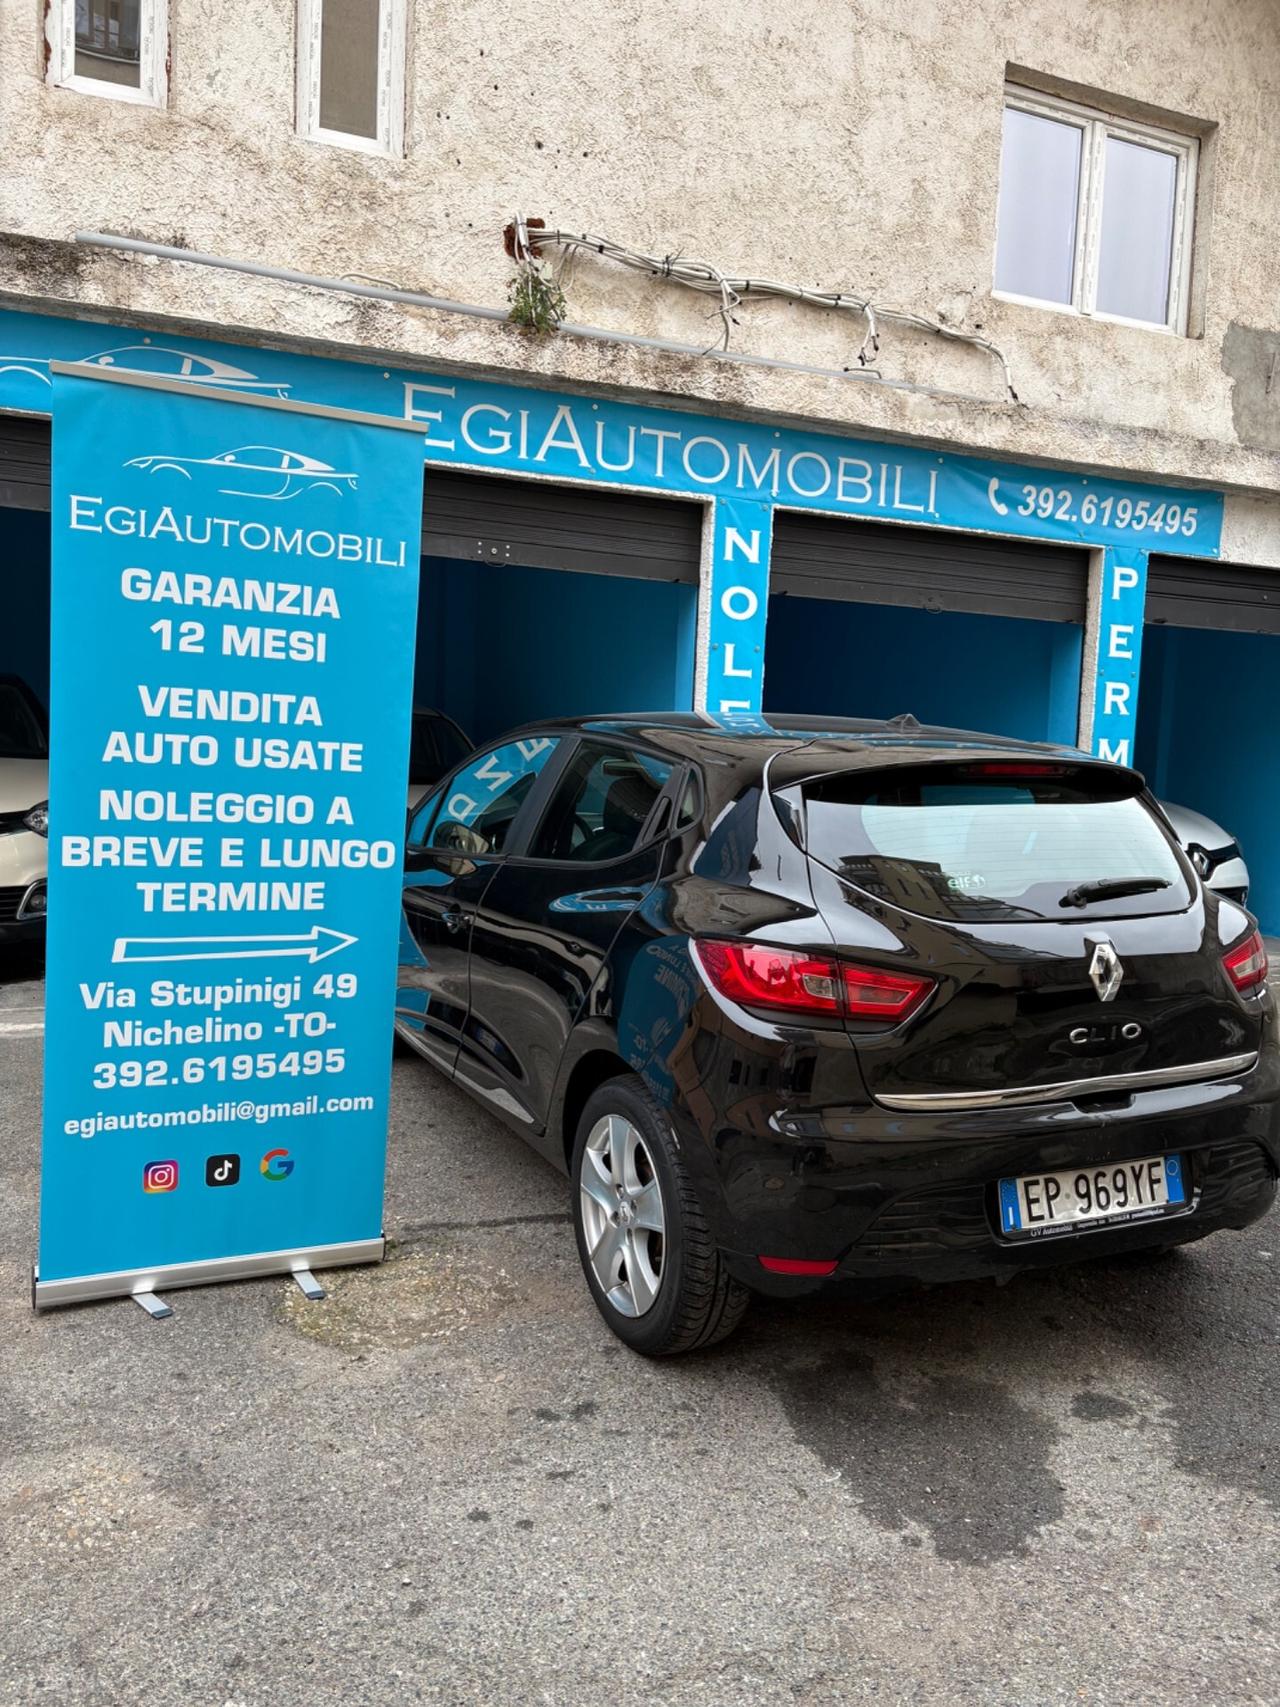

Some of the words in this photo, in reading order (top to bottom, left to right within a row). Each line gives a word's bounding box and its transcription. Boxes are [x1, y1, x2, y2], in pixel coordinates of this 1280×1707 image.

[1017, 484, 1199, 537] 392.6195495
[121, 567, 341, 619] GARANZIA
[150, 618, 205, 654] 12
[222, 624, 327, 663] MESI
[138, 684, 323, 727] VENDITA
[102, 731, 219, 766] AUTO
[234, 737, 364, 773] USATE
[99, 789, 314, 825] NOLEGGIO
[325, 796, 354, 825] A
[61, 835, 204, 868] BREVE
[220, 837, 244, 868] E
[260, 838, 396, 869] LUNGO
[136, 881, 325, 913] TERMINE
[79, 981, 136, 1010] Via
[150, 975, 301, 1012] Stupinigi
[312, 973, 358, 999] 49
[103, 1016, 263, 1048] Nichelino
[274, 1011, 337, 1038] -TO-
[1069, 1022, 1142, 1044] CLIO
[93, 1048, 345, 1089] 392.6195495
[64, 1095, 374, 1139] egiautomobili@gmail.com
